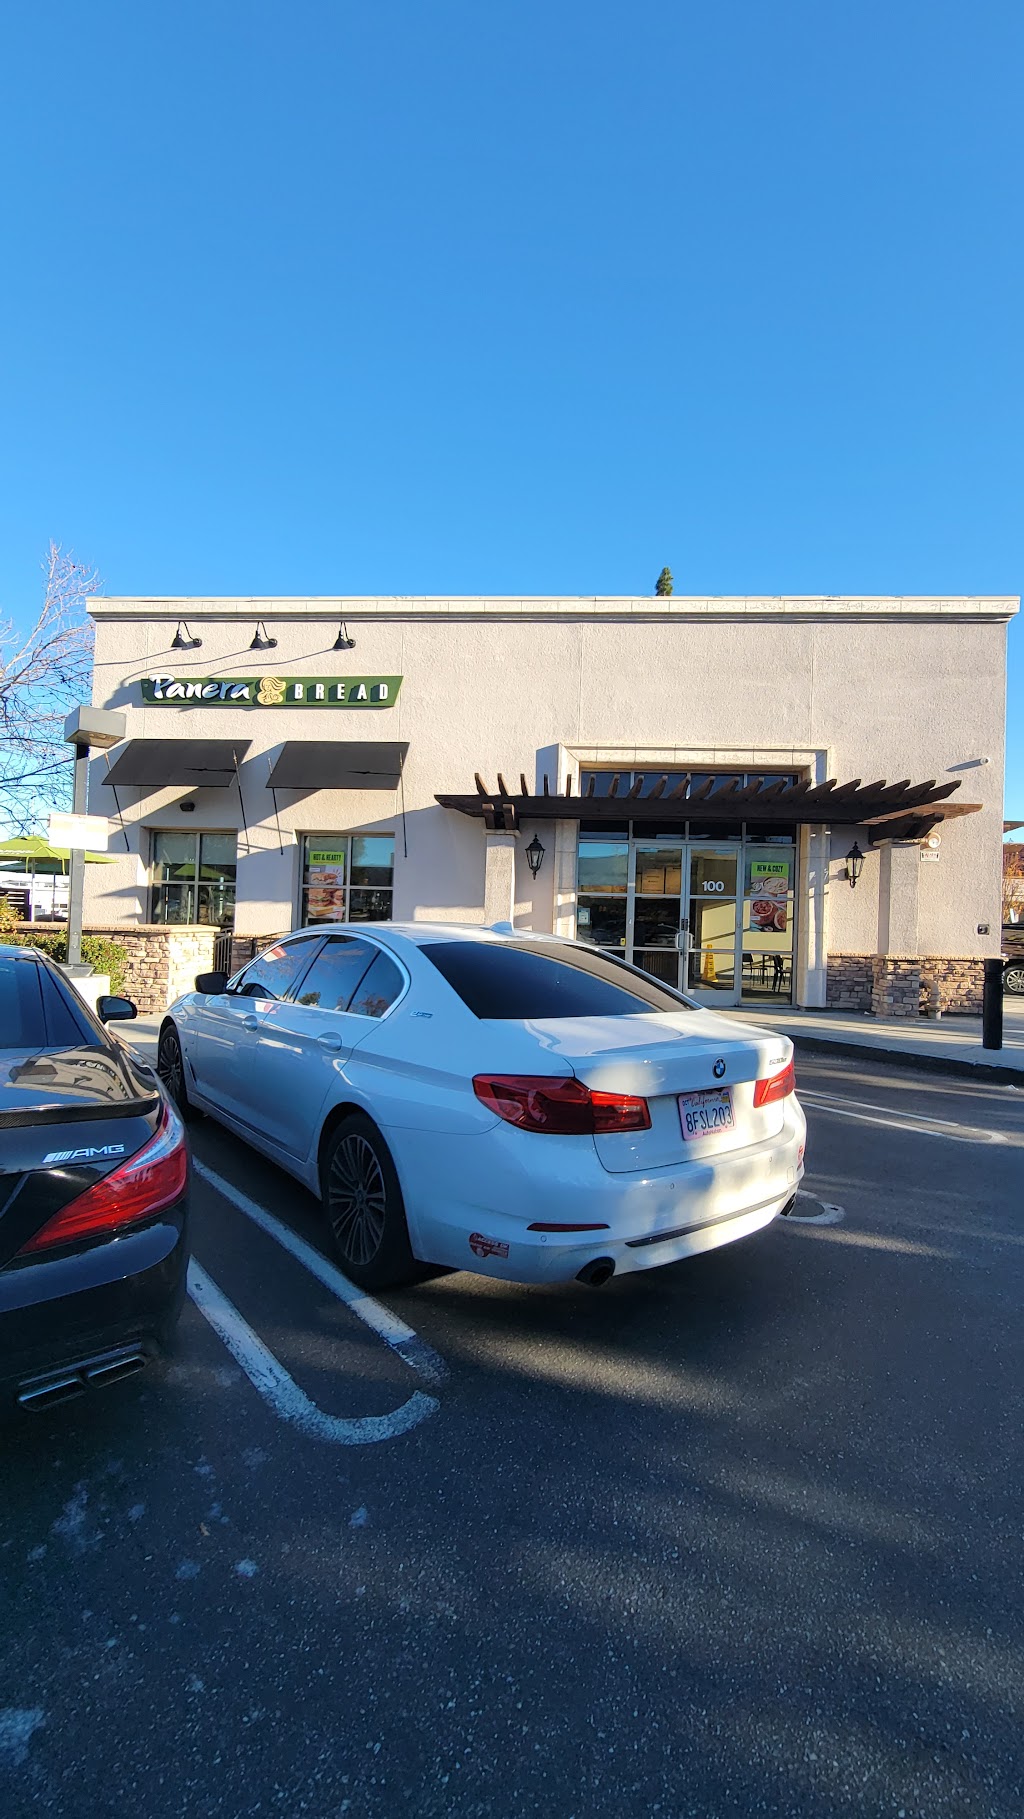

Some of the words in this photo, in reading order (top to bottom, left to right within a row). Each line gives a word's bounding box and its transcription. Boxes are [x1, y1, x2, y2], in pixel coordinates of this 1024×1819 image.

[148, 673, 250, 699] Panera
[294, 683, 389, 700] BREAD
[702, 880, 725, 892] 100
[686, 1106, 732, 1132] 8FSL203
[71, 1144, 125, 1159] AMG
